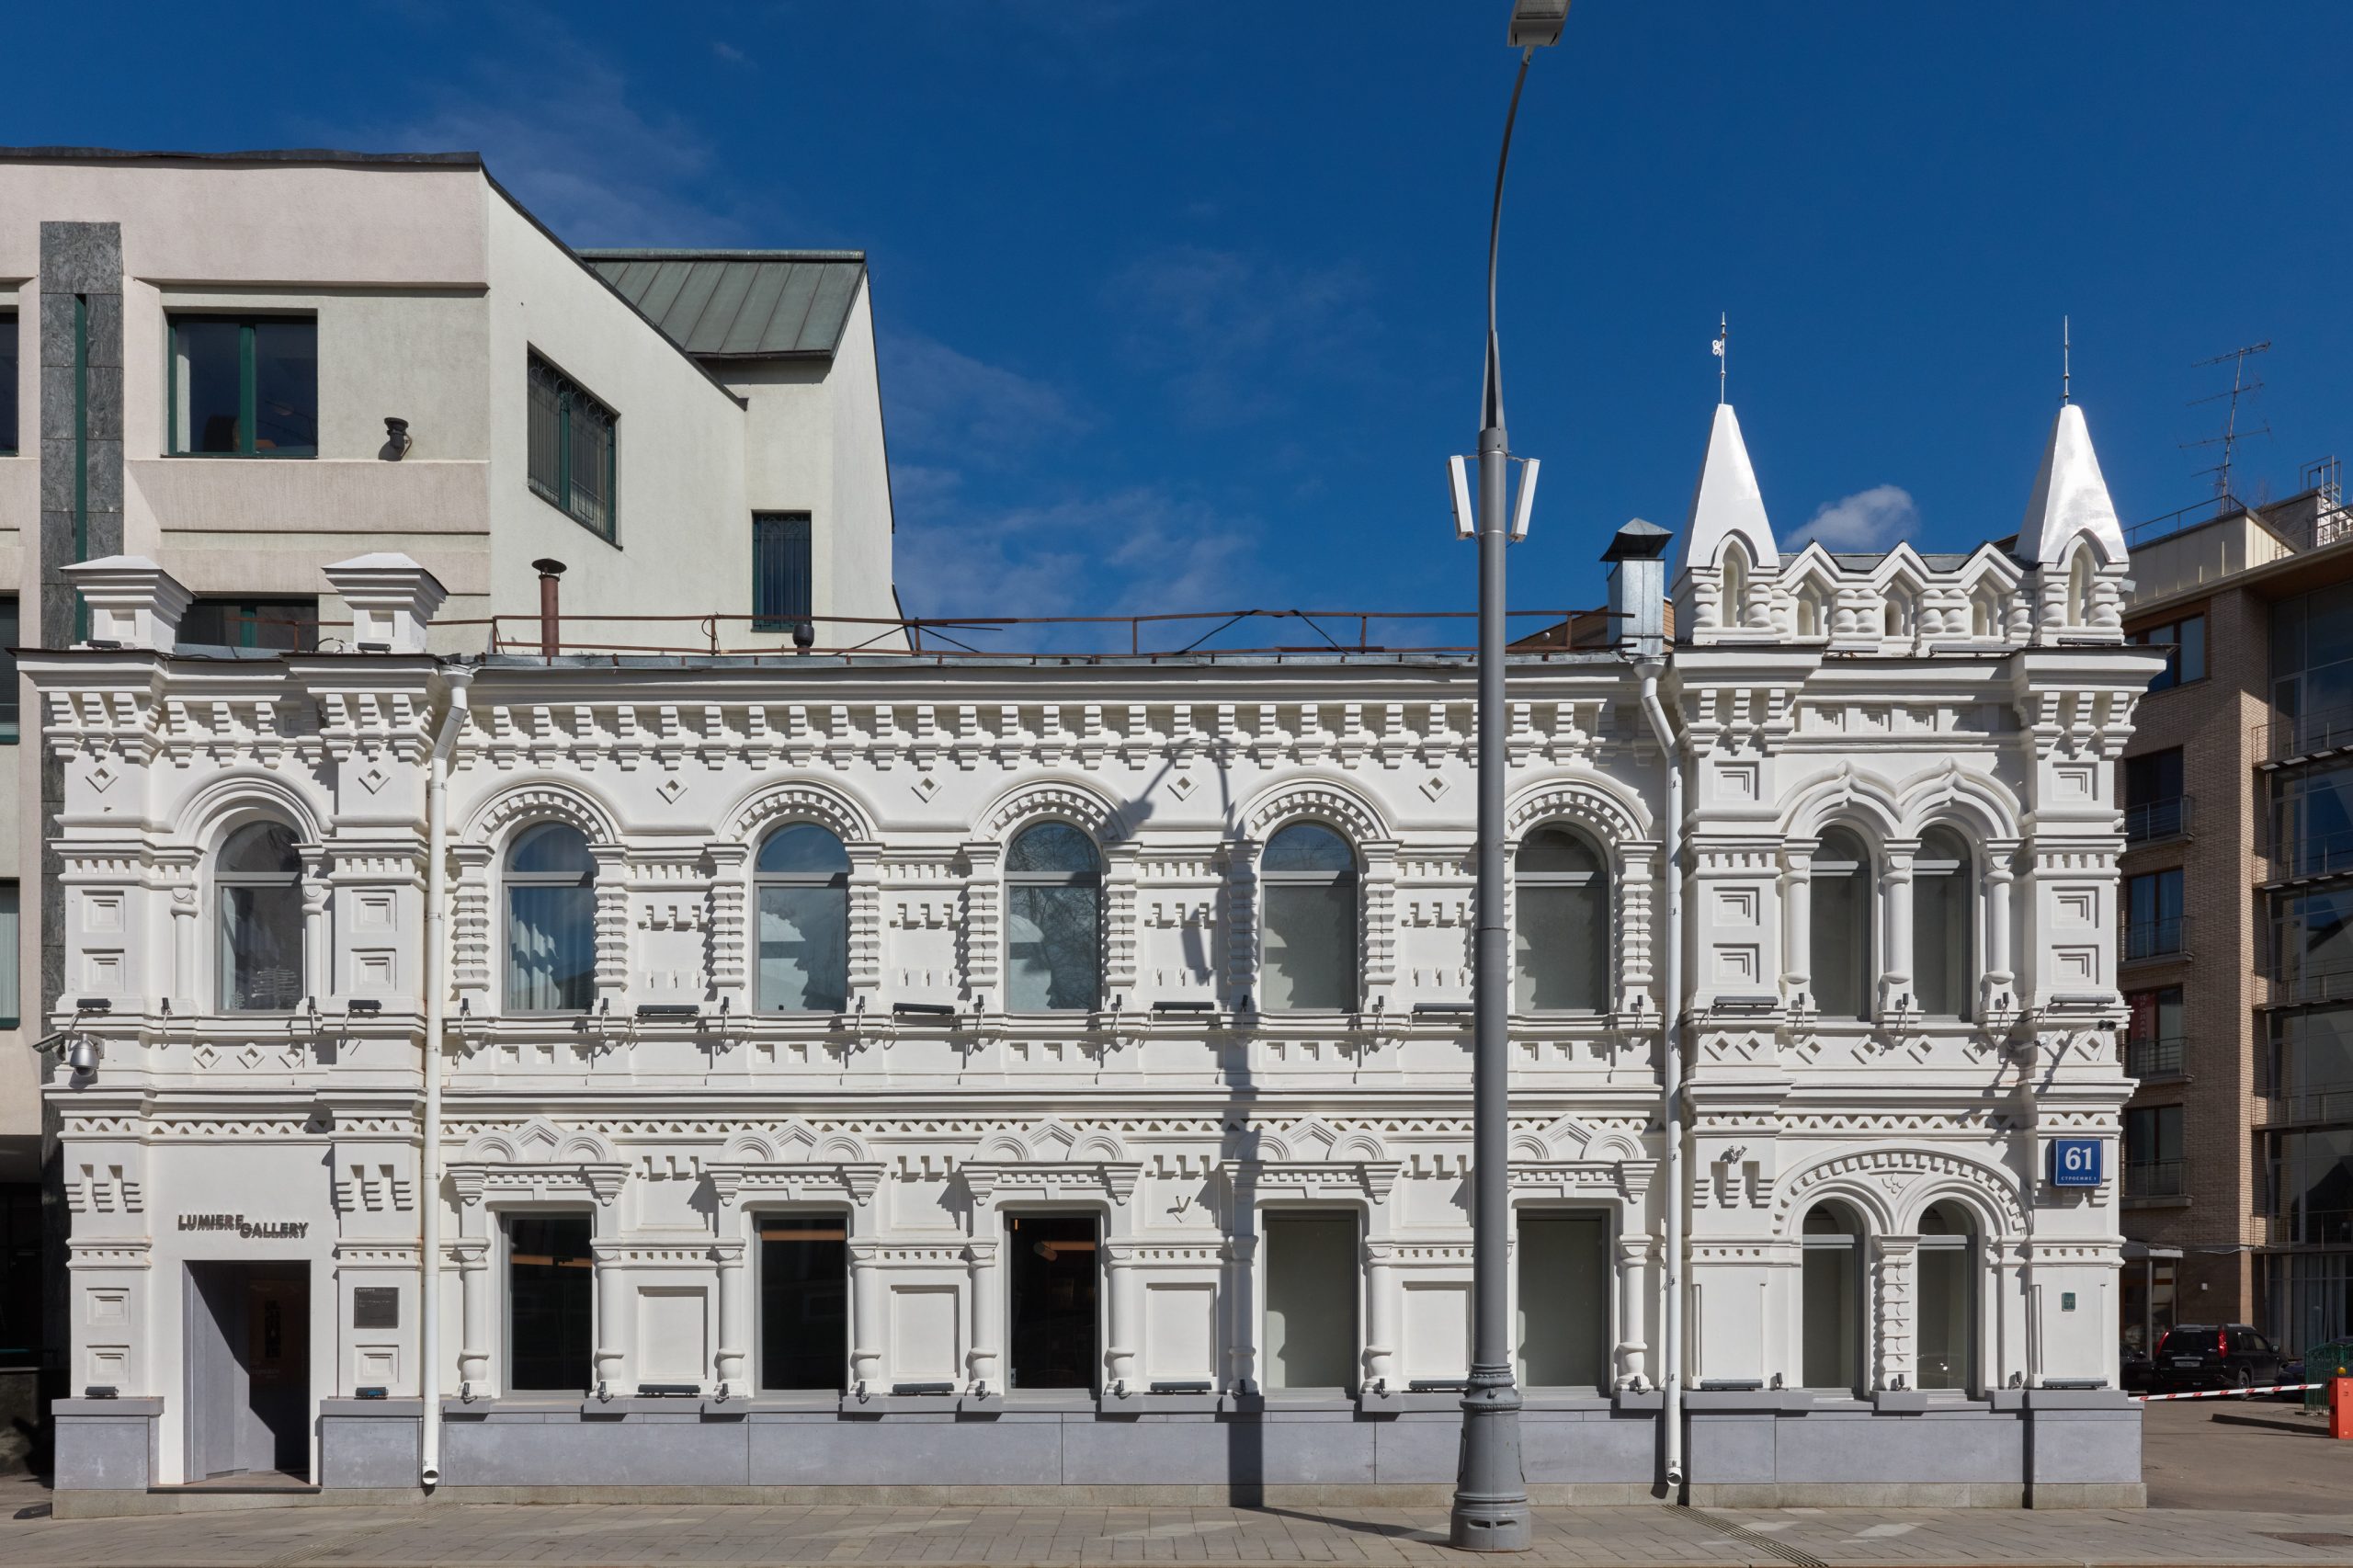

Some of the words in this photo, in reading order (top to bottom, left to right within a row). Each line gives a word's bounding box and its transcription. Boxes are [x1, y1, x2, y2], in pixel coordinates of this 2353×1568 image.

[2064, 1146, 2092, 1171] 61
[177, 1214, 244, 1231] LUMIERE
[239, 1222, 309, 1239] GALLERY
